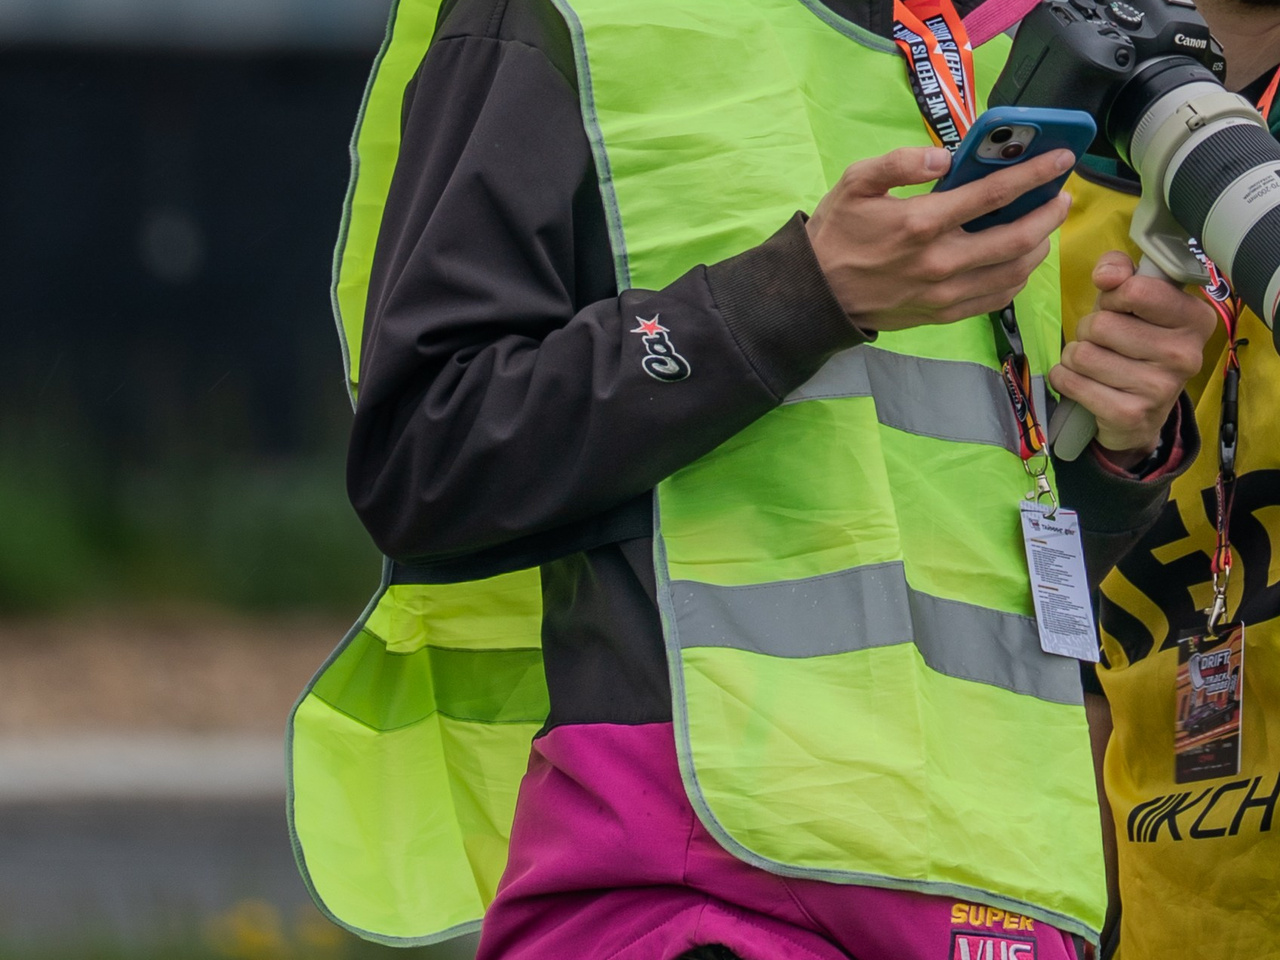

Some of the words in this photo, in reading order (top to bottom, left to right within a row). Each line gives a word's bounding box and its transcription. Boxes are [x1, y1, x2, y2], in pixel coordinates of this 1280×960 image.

[911, 43, 927, 59] IS
[1174, 33, 1208, 49] Canon
[1212, 62, 1224, 71] EOS
[915, 61, 940, 95] NEED
[926, 92, 950, 118] WE
[936, 117, 961, 145] ALL
[1201, 652, 1229, 670] DRIFT
[951, 903, 1034, 931] SUPER
